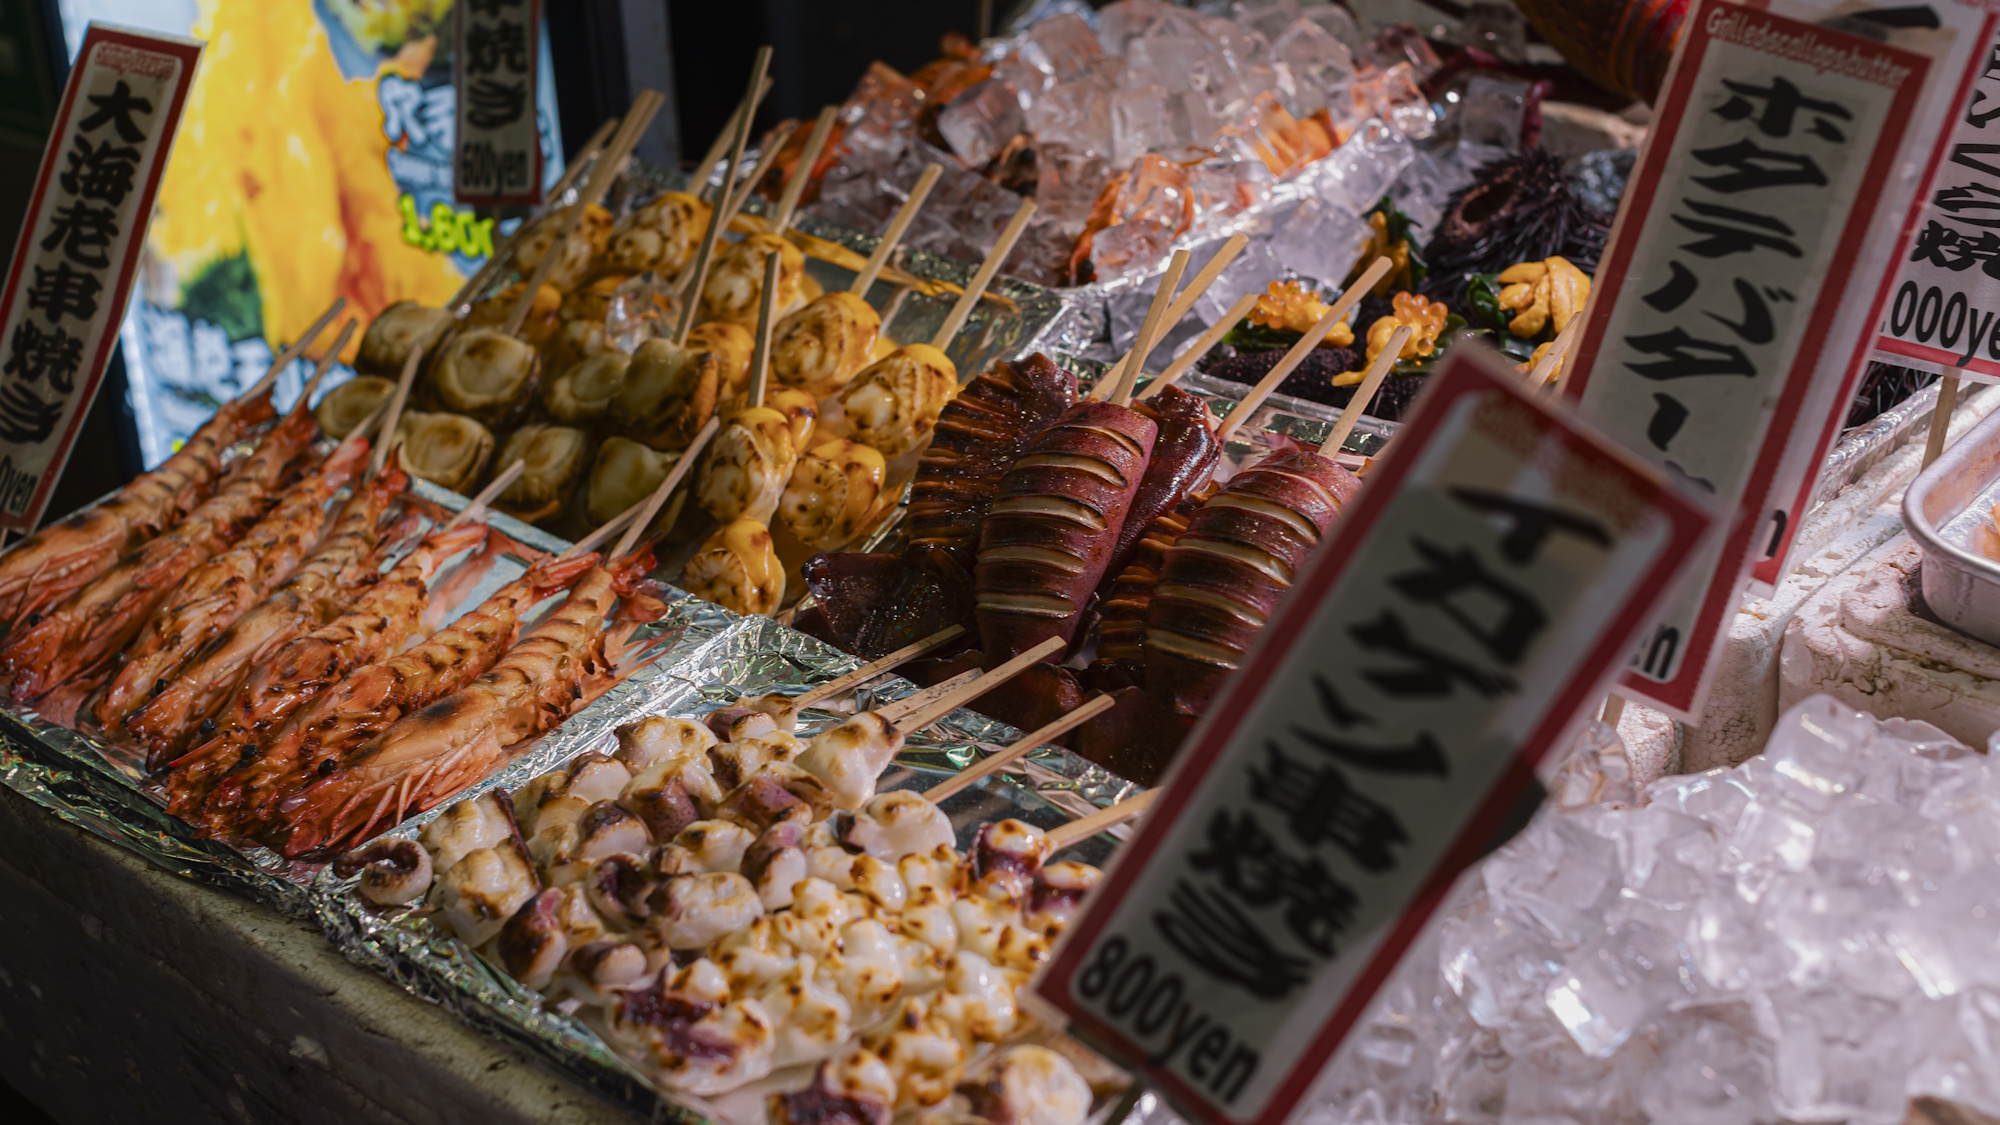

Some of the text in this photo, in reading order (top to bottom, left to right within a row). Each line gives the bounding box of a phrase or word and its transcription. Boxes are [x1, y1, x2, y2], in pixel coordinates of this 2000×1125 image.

[0, 79, 153, 444] 大海老串焼き
[1622, 75, 1856, 495] ホタテバター
[1153, 484, 1614, 999] イカゲソ串焼き
[1079, 933, 1261, 1106] 800yen
